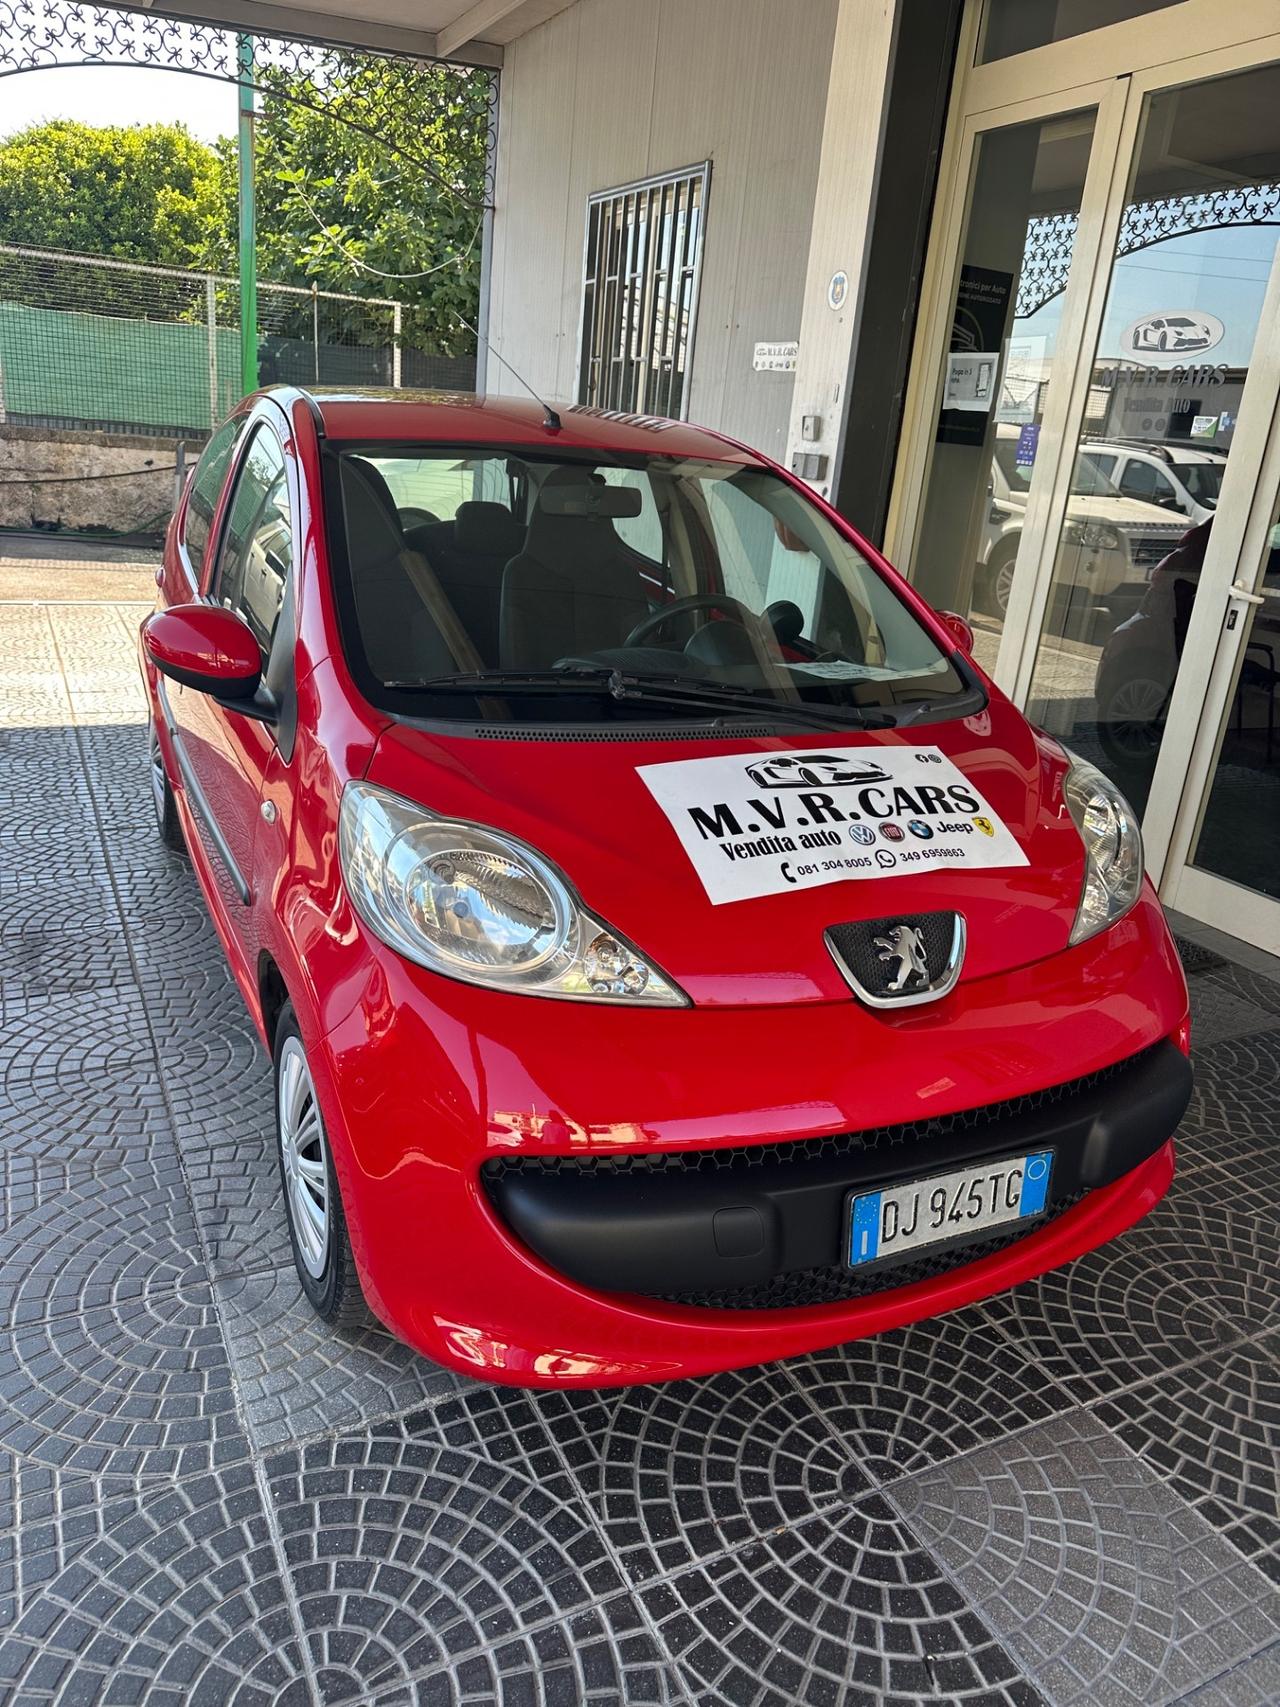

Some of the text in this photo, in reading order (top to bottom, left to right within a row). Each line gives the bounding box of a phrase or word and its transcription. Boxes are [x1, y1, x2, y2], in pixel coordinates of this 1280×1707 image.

[687, 784, 981, 841] M.V.R.CARS
[719, 832, 798, 861] Vendita
[799, 829, 842, 849] auto
[937, 820, 973, 836] Jeep
[797, 848, 966, 876] 081 304 8005 349 6959863
[881, 1168, 1023, 1243] DJ 945TG
